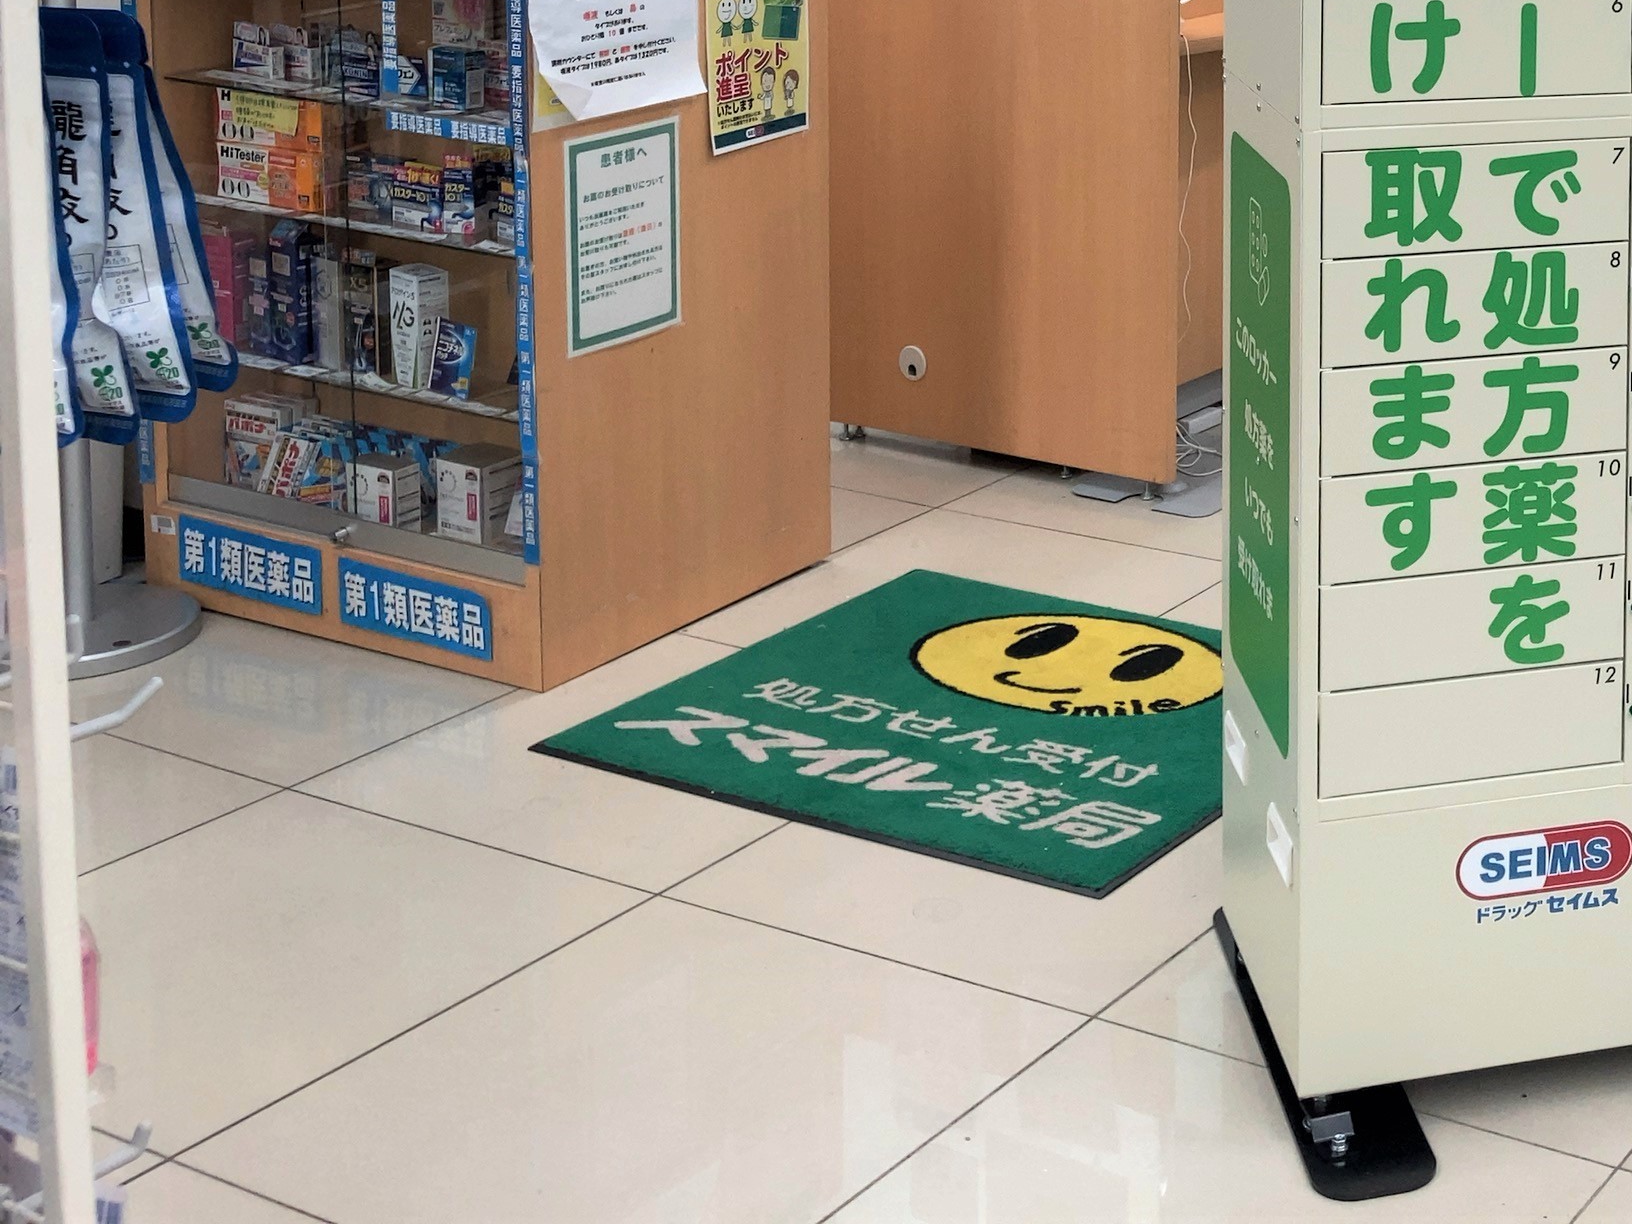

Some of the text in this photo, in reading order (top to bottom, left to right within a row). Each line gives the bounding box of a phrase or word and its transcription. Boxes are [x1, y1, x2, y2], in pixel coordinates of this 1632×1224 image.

[382, 0, 397, 71] 要指導医薬品
[715, 42, 789, 77] ポイント
[715, 72, 752, 102] 進呈
[716, 97, 755, 118] いたします
[390, 113, 506, 145] 要指導医薬品 要指導医薬品
[220, 145, 266, 164] HiTester
[601, 147, 647, 169] 患者様へ
[1611, 147, 1624, 165] 7
[583, 175, 664, 203] お薬のお受け取りについて
[1609, 250, 1621, 268] 8
[516, 256, 530, 343] 第一類医薬品
[1235, 317, 1279, 386] このロッカー
[1609, 353, 1621, 371] 9
[520, 351, 532, 436] 第一類医薬品
[227, 417, 266, 434] バポナ
[1243, 399, 1275, 471] 処方薬を
[1599, 459, 1621, 477] 10
[524, 466, 536, 546] 第一類医薬品
[1244, 476, 1275, 546] いつでも
[183, 527, 315, 604] 第1類医薬品
[1597, 562, 1616, 580] 11
[344, 571, 485, 651] 第1類医薬品
[1594, 666, 1617, 684] 12
[743, 677, 1160, 790] 処方せん受付
[614, 705, 1162, 850] スマイル薬局
[1478, 837, 1613, 884] SEIMS
[1475, 889, 1620, 923] ドラッグセイムス
